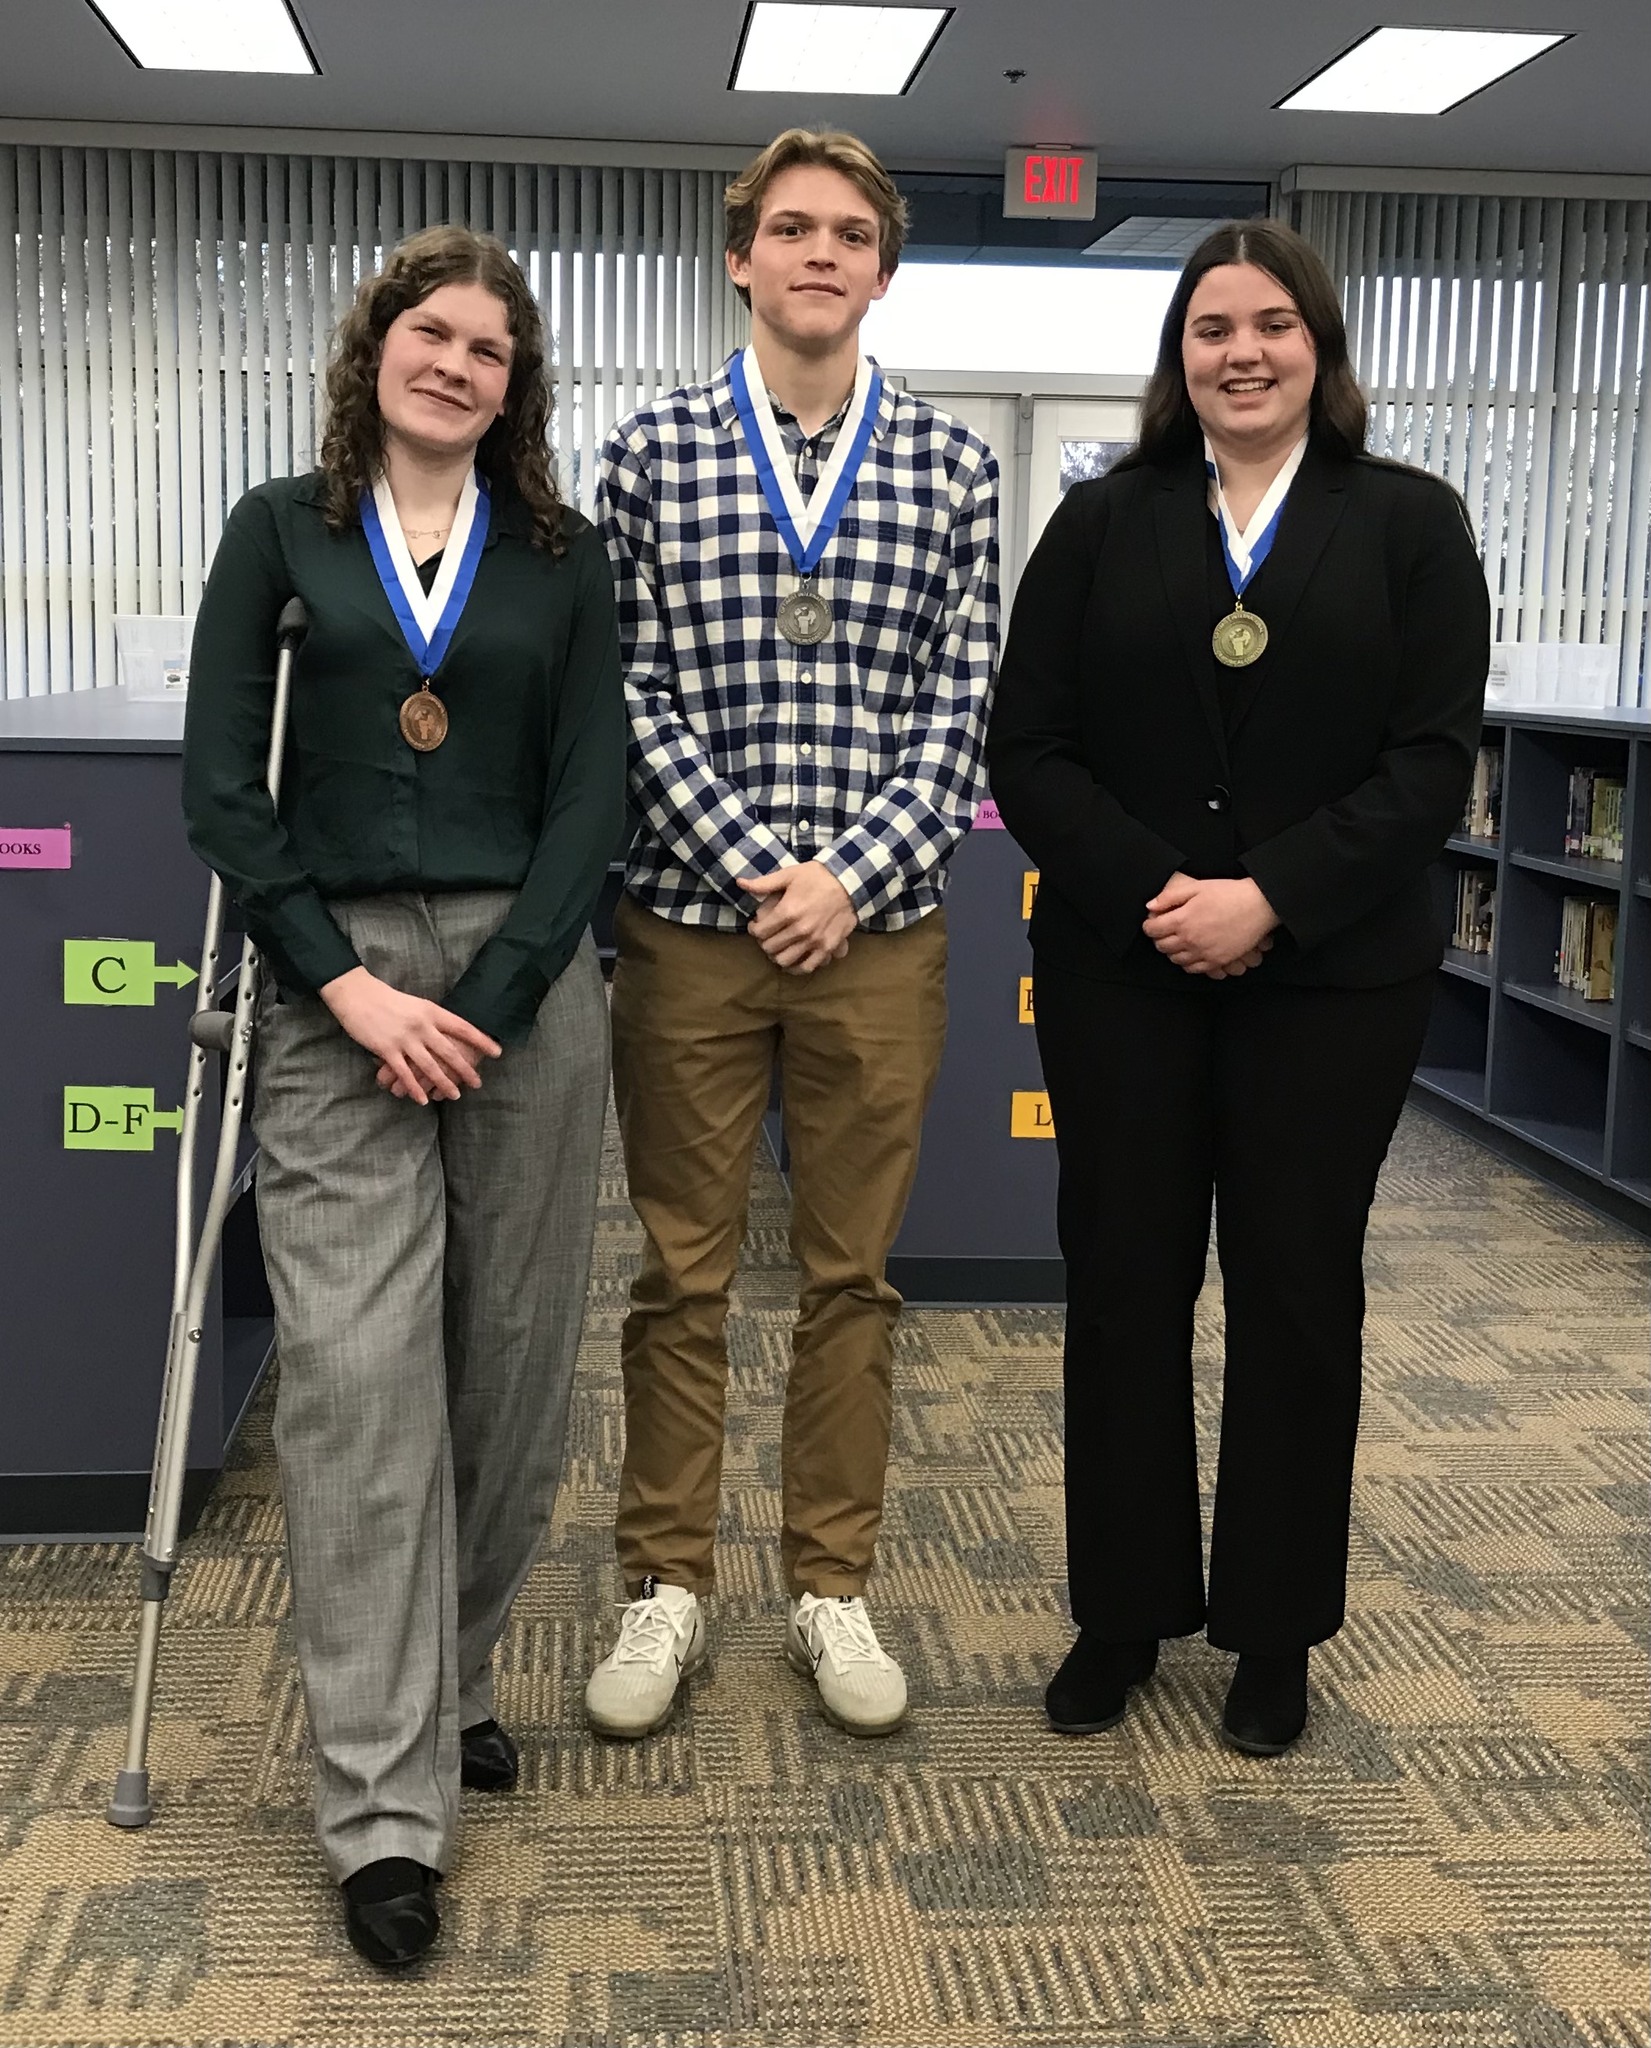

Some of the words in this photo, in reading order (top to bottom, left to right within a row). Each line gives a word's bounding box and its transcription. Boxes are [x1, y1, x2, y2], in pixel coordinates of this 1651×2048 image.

[1024, 155, 1084, 205] EXIT
[91, 956, 127, 994] C
[68, 1102, 149, 1135] D-F
